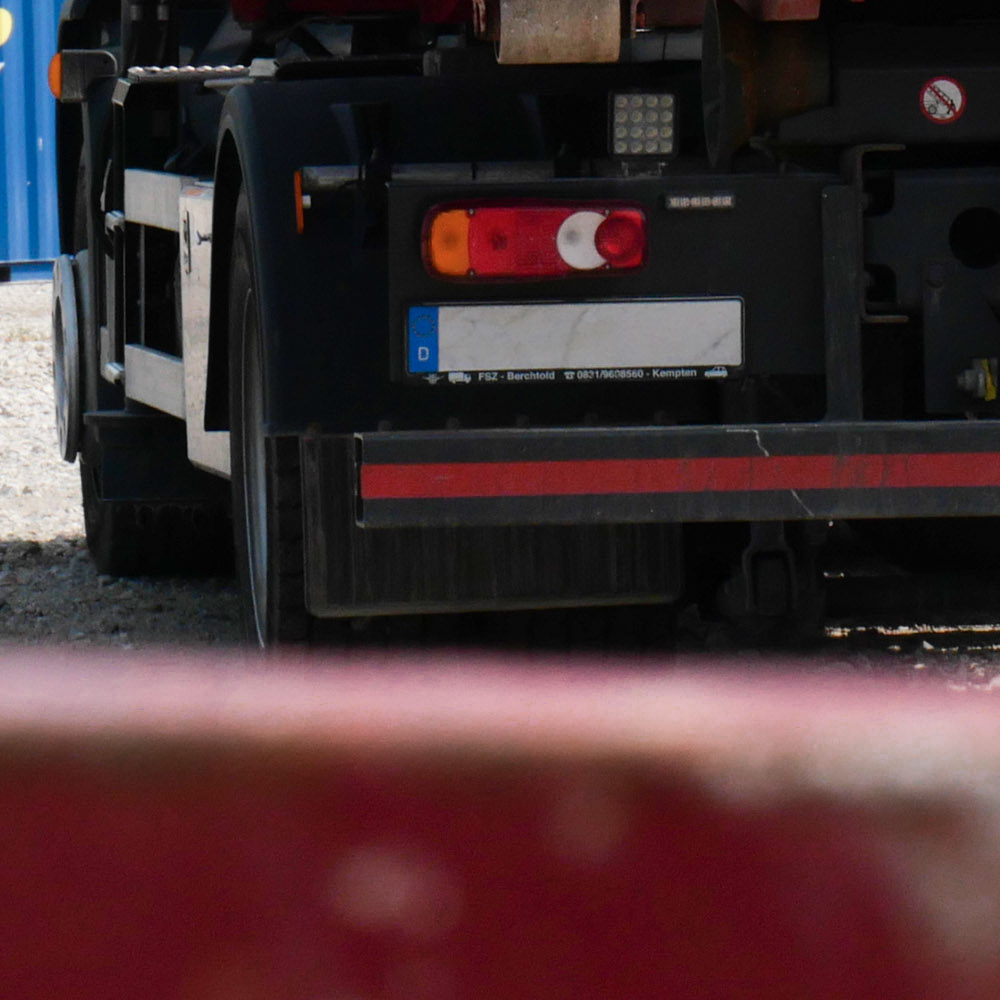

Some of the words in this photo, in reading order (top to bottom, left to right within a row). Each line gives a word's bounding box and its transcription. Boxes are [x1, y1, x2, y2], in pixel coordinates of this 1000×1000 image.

[418, 346, 430, 362] D
[478, 372, 498, 381] FSZ
[507, 371, 555, 381] Berchtold
[652, 368, 697, 379] Kempten
